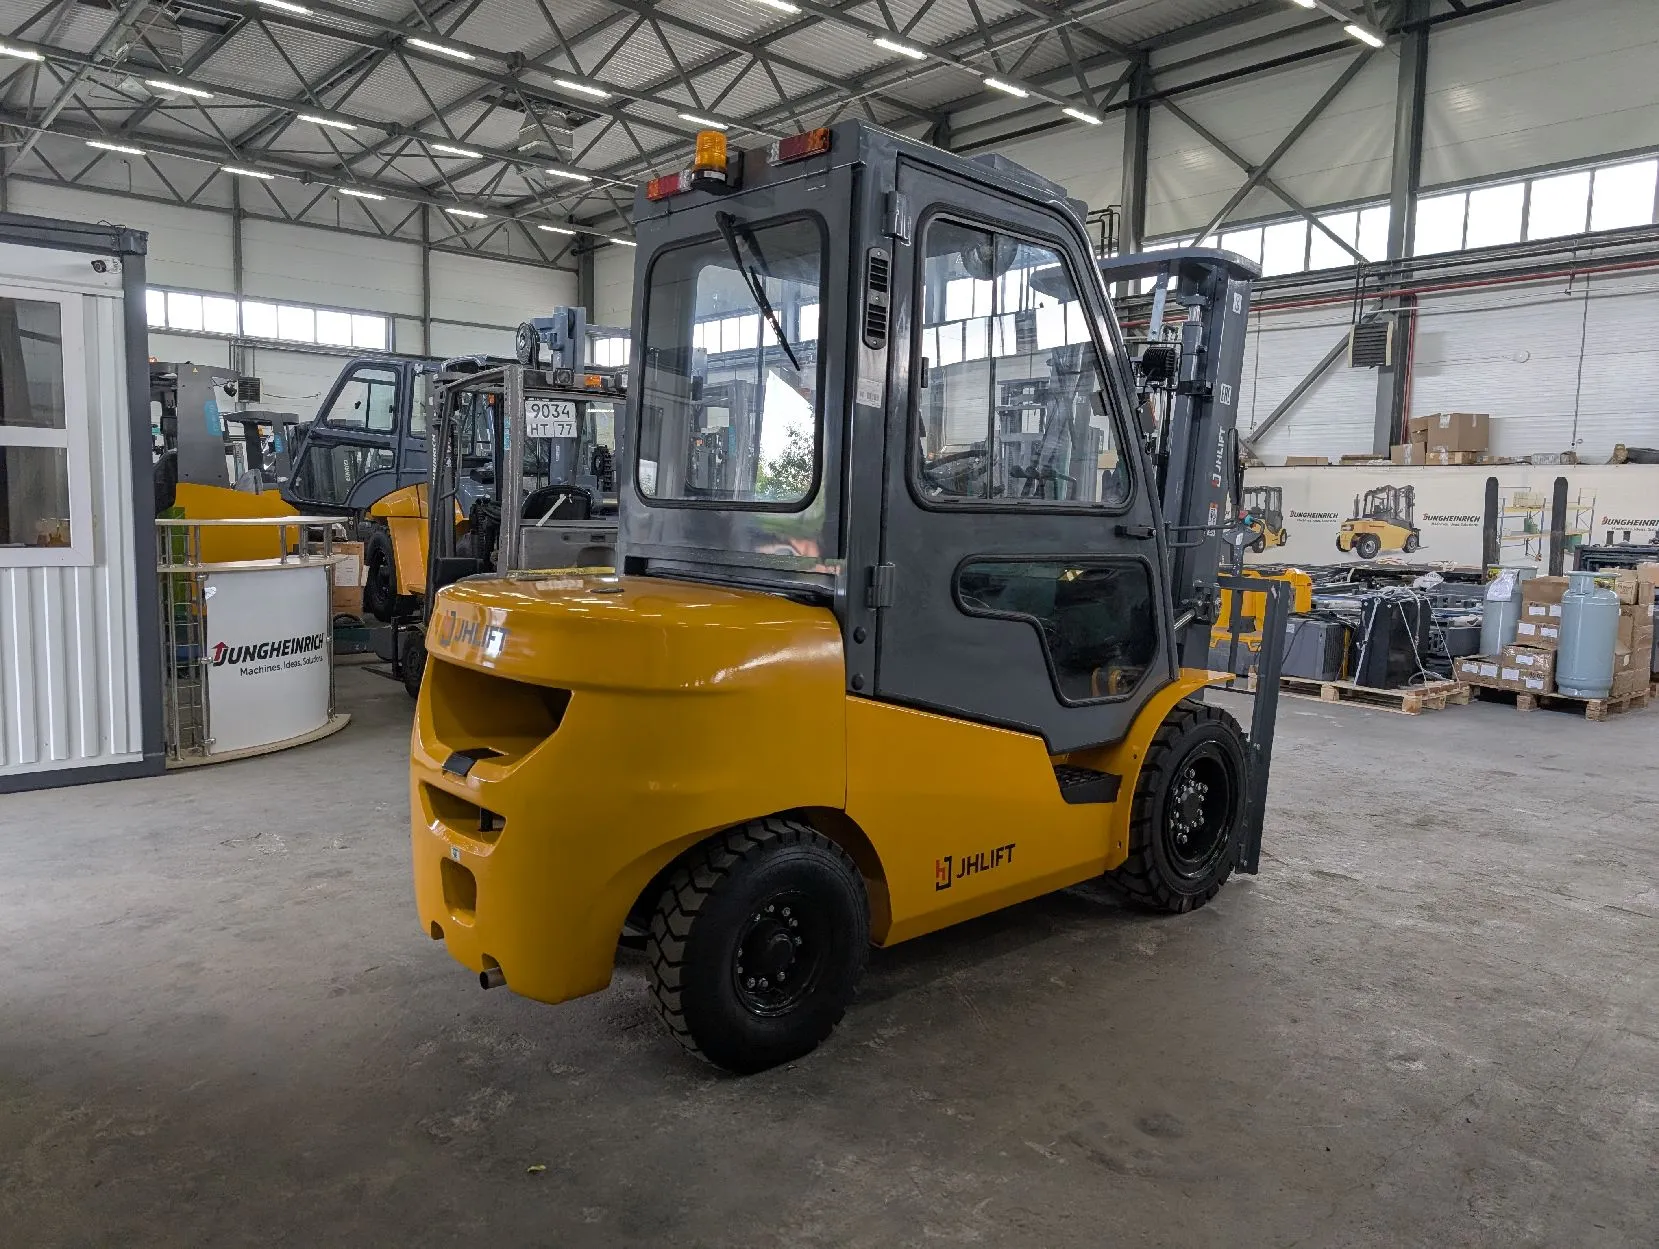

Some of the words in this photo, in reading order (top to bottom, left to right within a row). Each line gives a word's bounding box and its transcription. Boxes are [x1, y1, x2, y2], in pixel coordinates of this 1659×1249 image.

[531, 403, 570, 418] 9034
[557, 423, 573, 435] 77
[1290, 510, 1339, 519] JUNGHEINRICH
[1423, 513, 1480, 522] JUNGHEINRICH
[1601, 516, 1659, 526] JUNGHEINRI
[212, 633, 324, 667] JUNGHEINRICH
[956, 843, 1016, 879] JHLIFT
